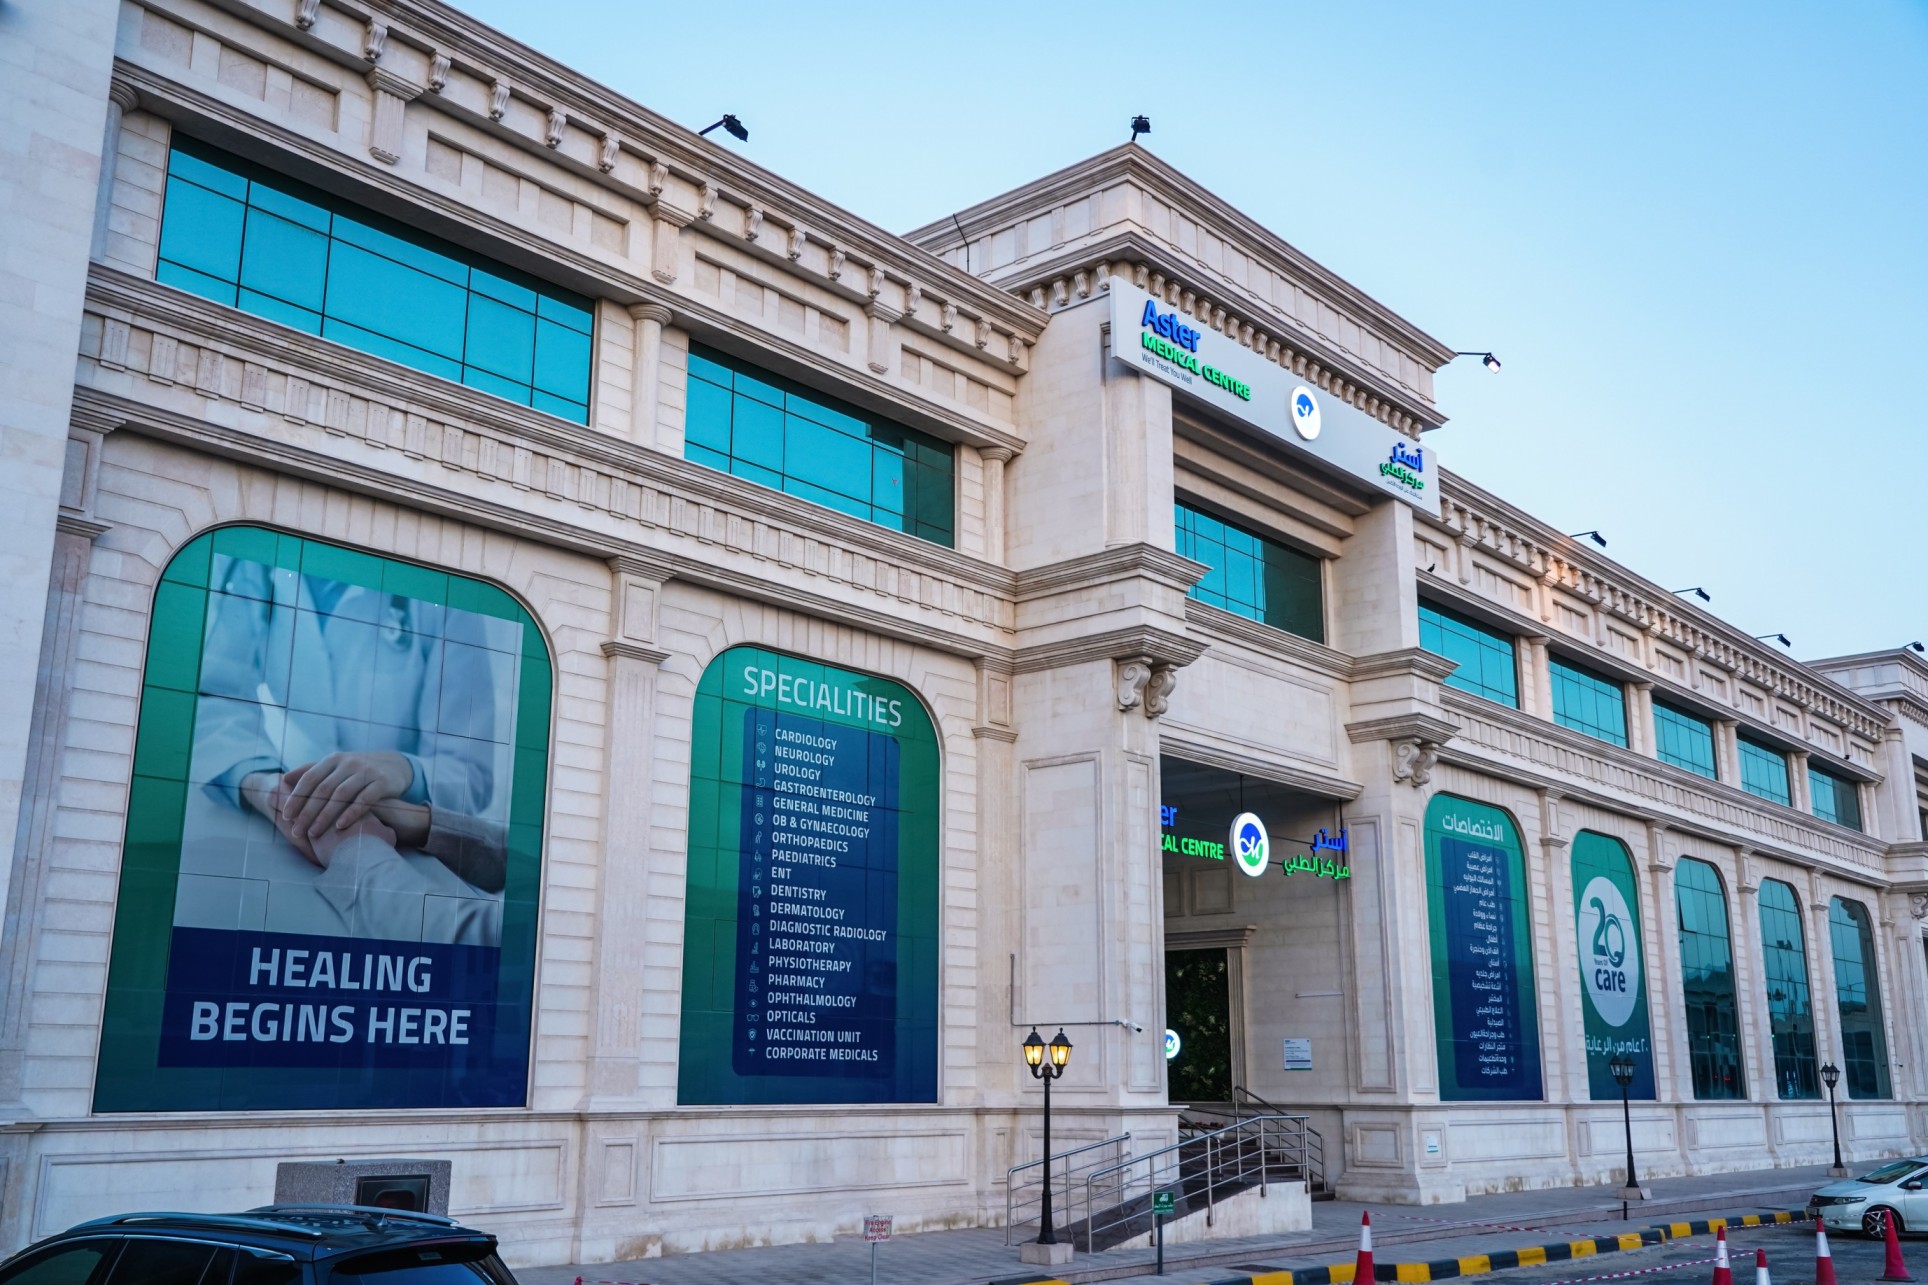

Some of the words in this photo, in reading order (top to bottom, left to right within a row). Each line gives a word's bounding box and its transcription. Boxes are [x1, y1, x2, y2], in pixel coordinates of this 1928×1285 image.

[1142, 299, 1200, 352] Aster
[1142, 331, 1201, 376] MEDICAL
[1202, 364, 1251, 401] CENTRE
[1156, 360, 1170, 374] Treat
[1170, 367, 1180, 379] You
[1180, 372, 1193, 385] Well
[743, 666, 902, 727] SPECIALITIES
[775, 728, 837, 750] CARDIOLOGY
[774, 745, 835, 766] NEUROLOGY
[774, 762, 821, 781] UROLOGY
[773, 779, 876, 807] GASTROENTEROLOGY
[773, 797, 819, 814] GENERAL
[822, 804, 869, 822] MEDICINE
[772, 814, 786, 827] OB
[789, 816, 798, 828] &
[800, 818, 869, 839] GYNAECOLOGY
[1442, 813, 1504, 842] الاختصاصات
[772, 831, 849, 853] ORTHOPAEDICS
[1181, 837, 1224, 860] CENTRE
[771, 849, 837, 868] PAEDIATRICS
[771, 867, 792, 880] ENT
[770, 884, 826, 901] DENTISTRY
[770, 902, 845, 920] DERMATOLOGY
[769, 920, 831, 937] DIAGNOSTIC
[833, 926, 887, 941] RADIOLOGY
[769, 938, 835, 954] LABORATORY
[249, 947, 433, 993] HEALING
[768, 956, 851, 972] PHYSIOTHERAPY
[768, 974, 825, 989] PHARMACY
[1595, 968, 1626, 993] care
[767, 992, 856, 1008] OPHTHALMOLOGY
[190, 1001, 355, 1044] BEGINS
[367, 1006, 472, 1045] HERE
[767, 1010, 816, 1024] OPTICALS
[766, 1028, 835, 1042] VACCINATION
[837, 1031, 861, 1043] UNIT
[766, 1047, 827, 1060] CORPORATE
[829, 1049, 878, 1061] MEDICALS
